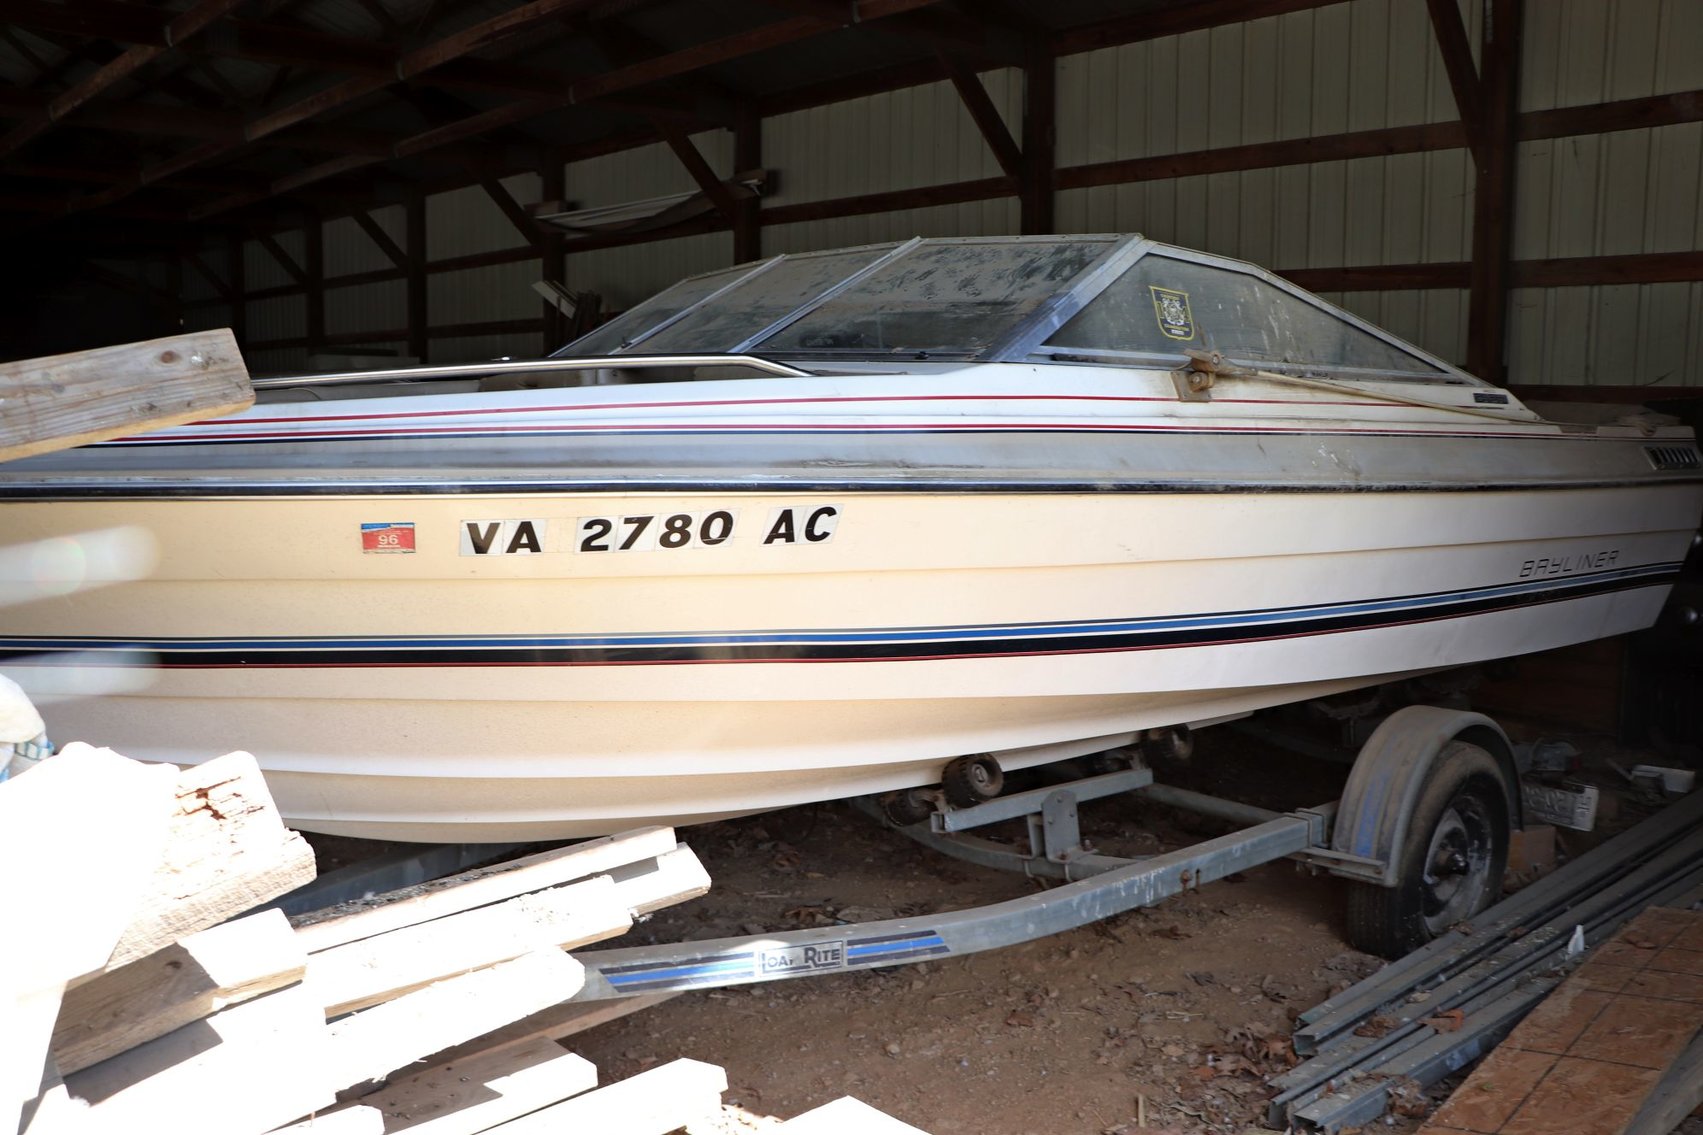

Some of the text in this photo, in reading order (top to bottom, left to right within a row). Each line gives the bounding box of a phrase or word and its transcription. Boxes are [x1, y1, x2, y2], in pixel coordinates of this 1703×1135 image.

[377, 534, 399, 545] 96
[466, 507, 837, 555] VA 2780 AC
[1519, 550, 1620, 577] BAYLINER
[804, 946, 841, 968] RITE
